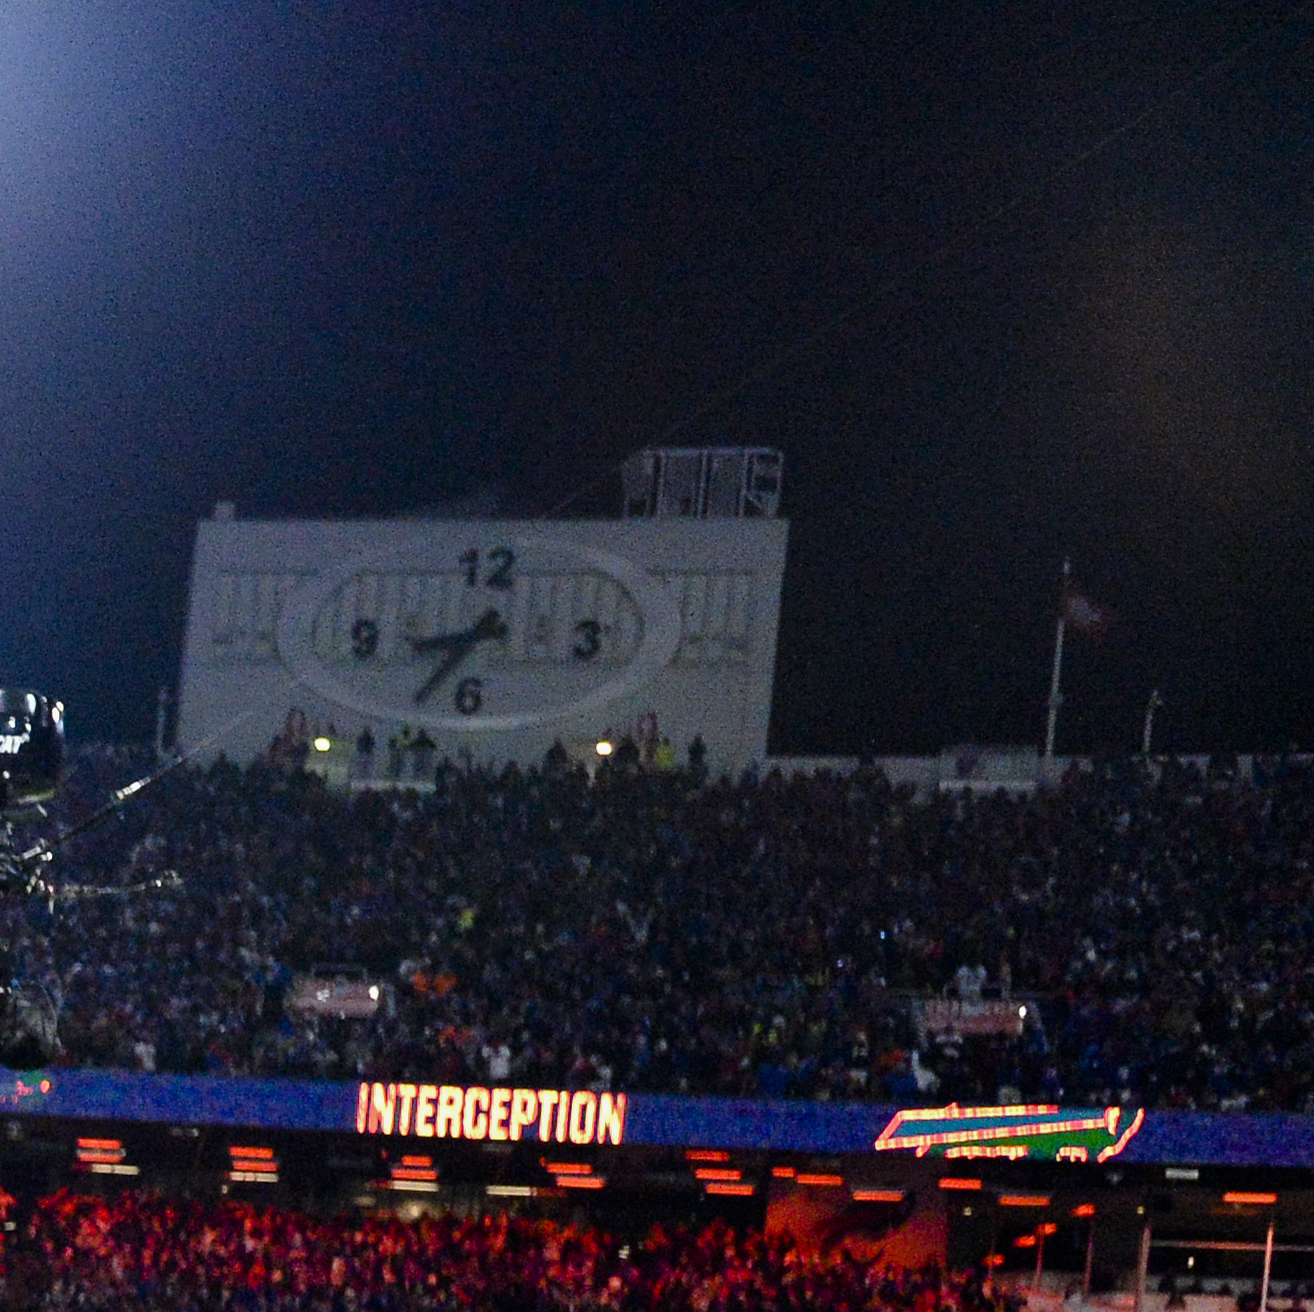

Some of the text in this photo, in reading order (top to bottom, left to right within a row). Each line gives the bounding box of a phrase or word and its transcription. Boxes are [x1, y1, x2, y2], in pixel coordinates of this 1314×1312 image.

[458, 547, 515, 590] 12
[352, 618, 603, 661] 9 3
[454, 676, 483, 716] 6
[355, 1081, 628, 1146] INTERCEPTION
